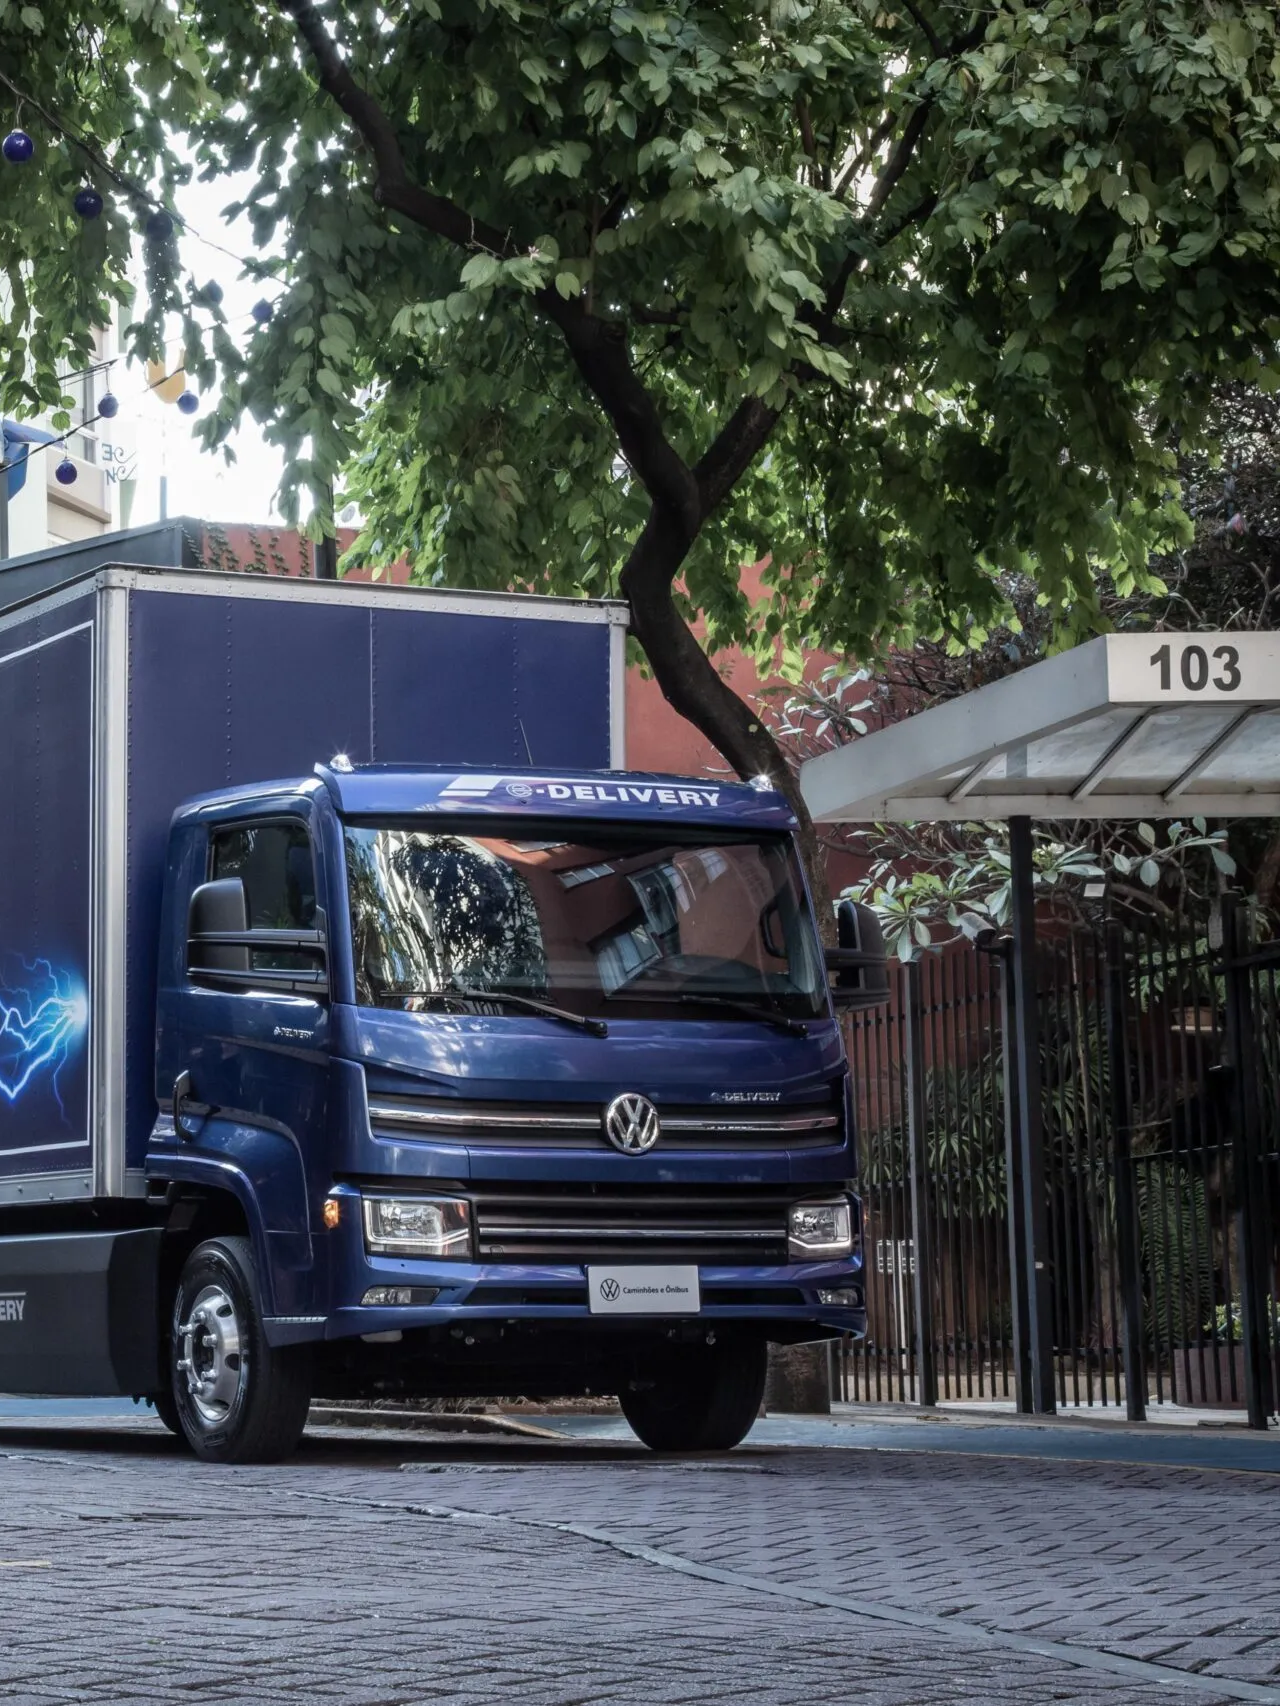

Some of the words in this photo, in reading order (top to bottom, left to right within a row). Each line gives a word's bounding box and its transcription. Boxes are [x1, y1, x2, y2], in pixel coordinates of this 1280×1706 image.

[1150, 644, 1242, 692] 103
[506, 781, 720, 807] e-DELIVERY
[607, 1093, 660, 1152] VW
[623, 1286, 659, 1295] Caminhões
[665, 1284, 689, 1294] Ônibus
